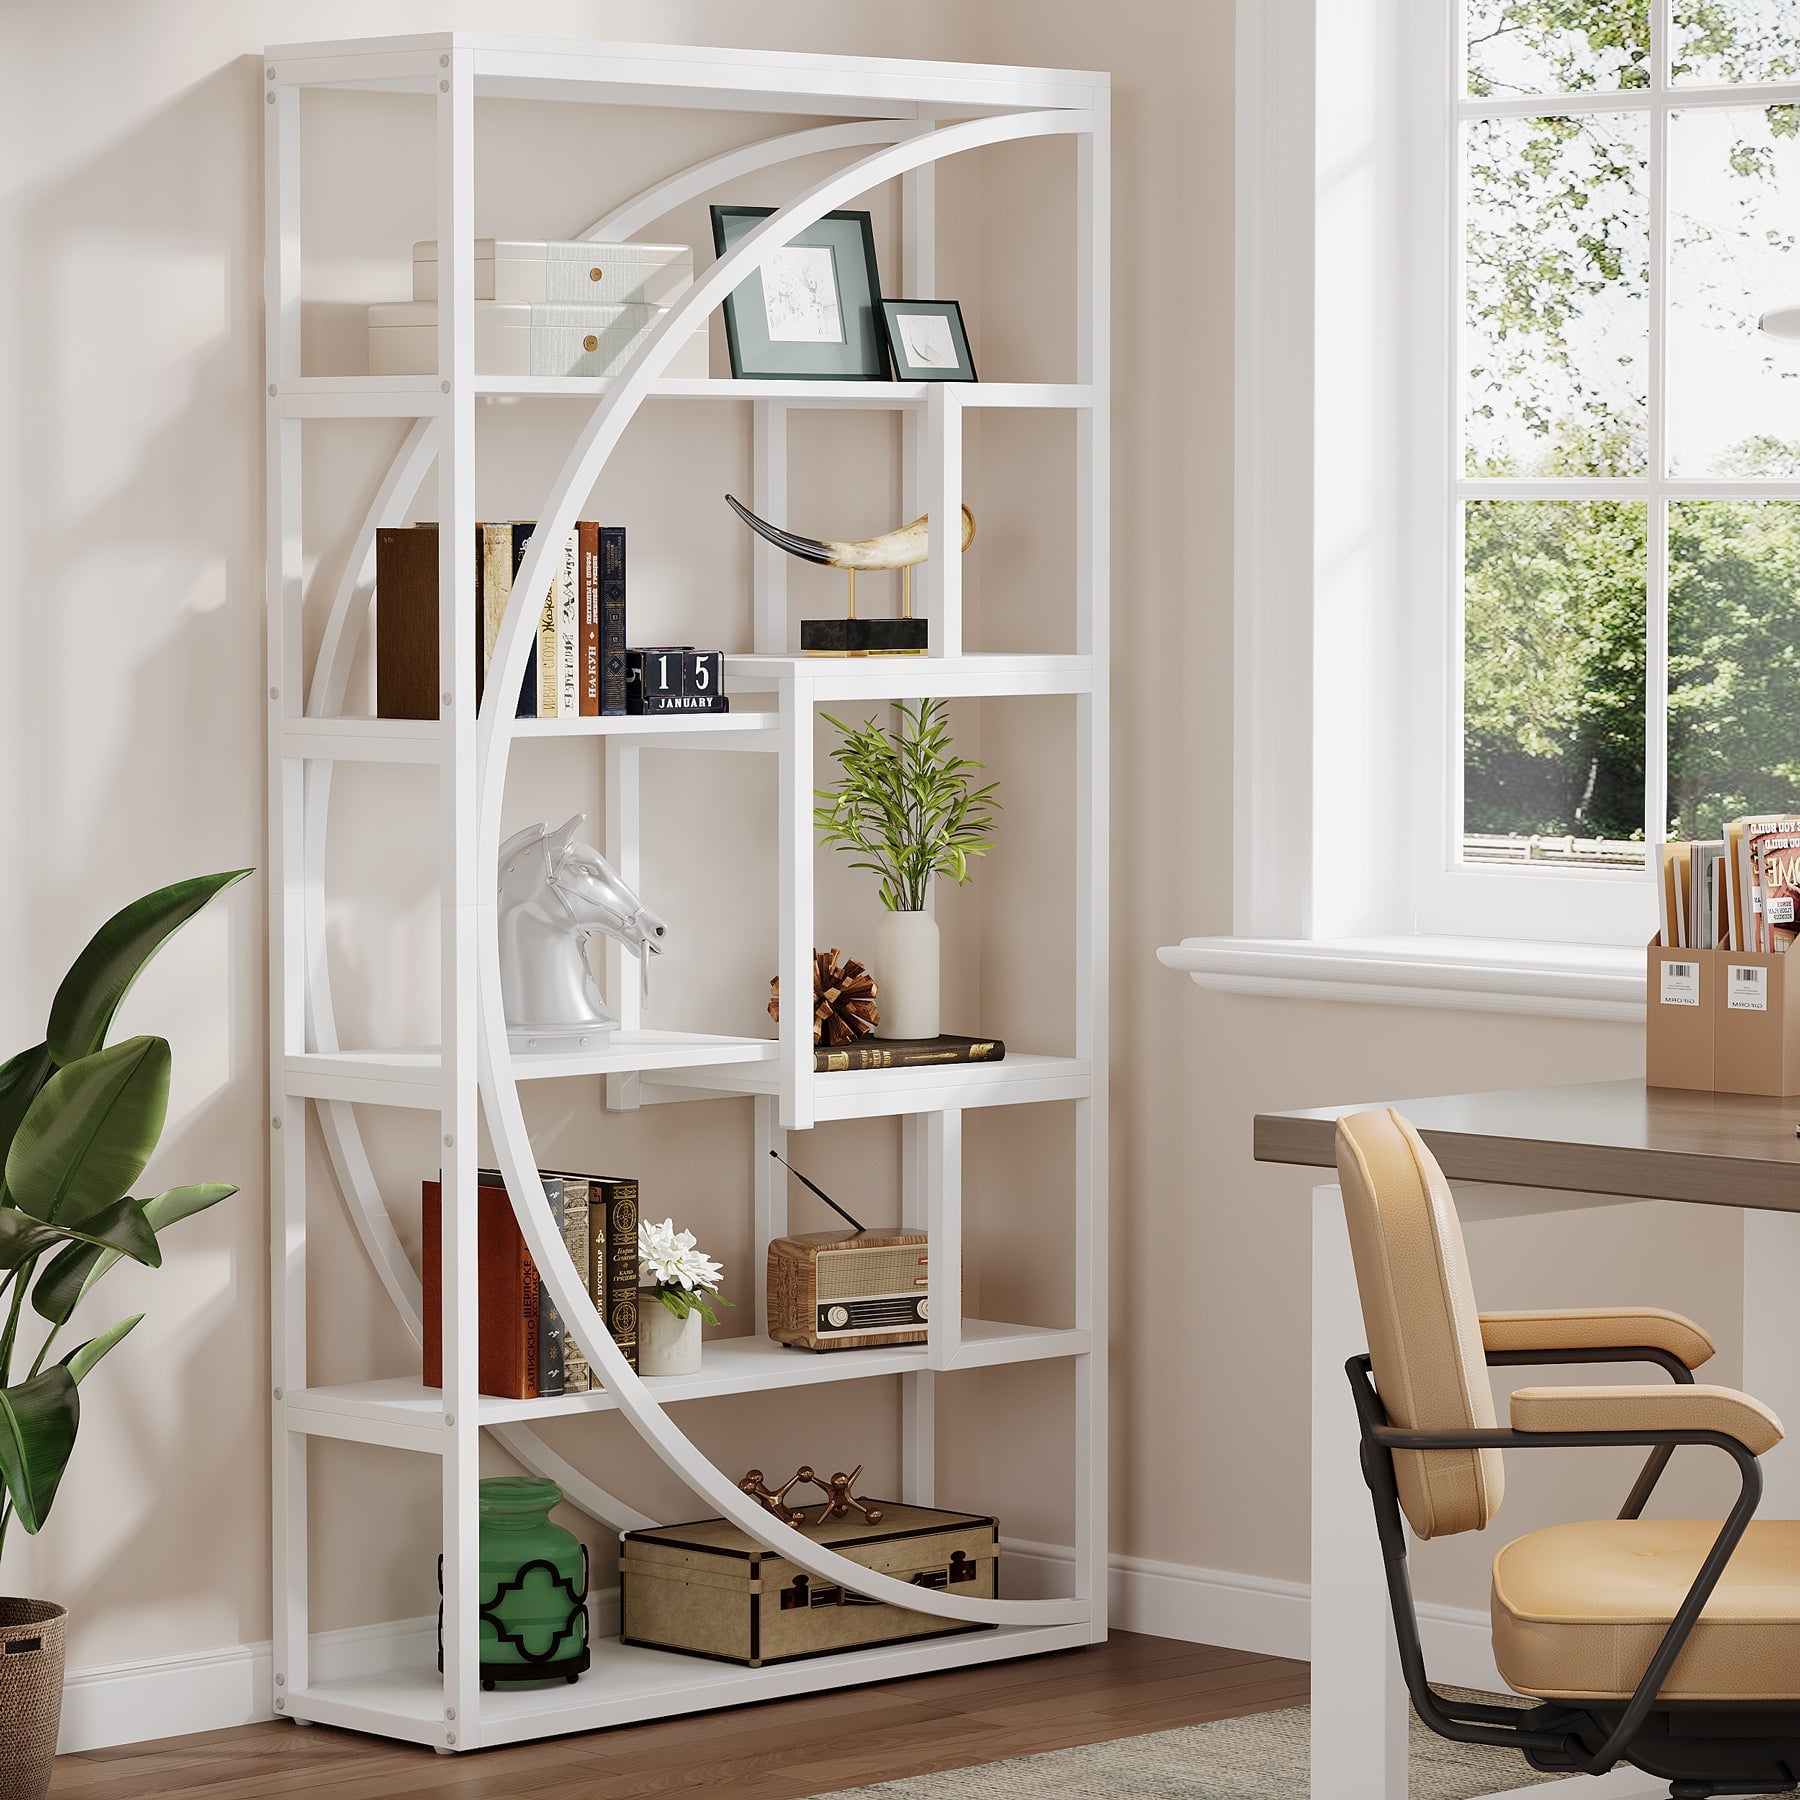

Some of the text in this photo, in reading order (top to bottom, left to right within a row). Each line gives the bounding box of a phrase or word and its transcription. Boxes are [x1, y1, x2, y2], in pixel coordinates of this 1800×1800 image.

[658, 697, 713, 709] JANUARY
[523, 1260, 532, 1318] ШЕРЛОКЕ
[527, 1331, 536, 1391] ЗАПИСКИ
